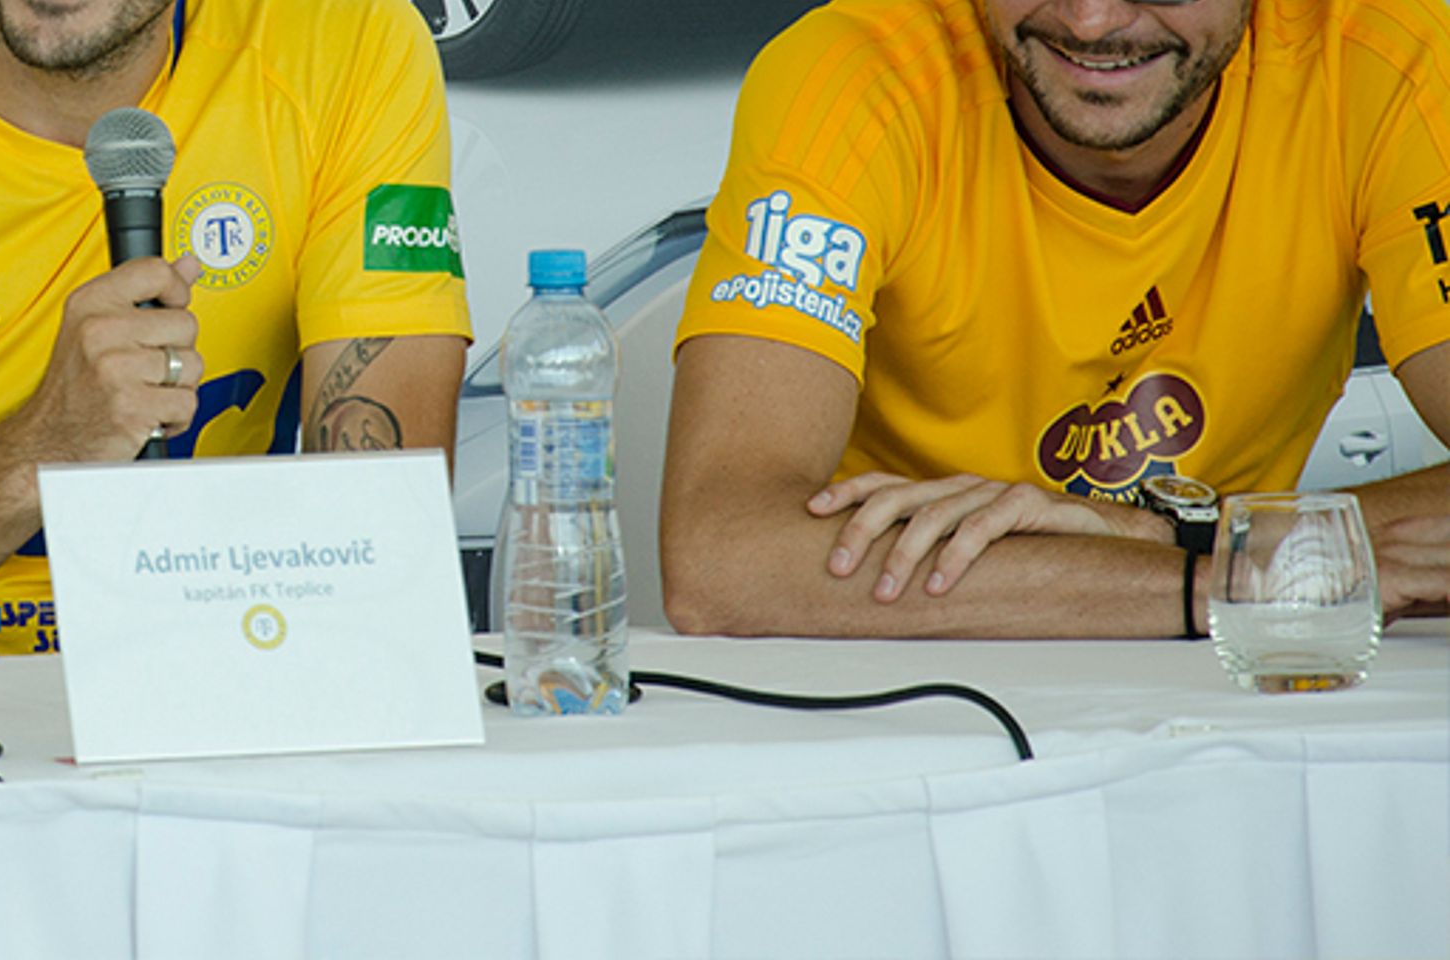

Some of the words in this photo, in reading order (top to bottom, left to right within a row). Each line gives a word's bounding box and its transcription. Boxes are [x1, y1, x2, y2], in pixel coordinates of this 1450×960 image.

[1412, 201, 1450, 265] T
[1111, 318, 1174, 356] adidas
[1054, 395, 1193, 461] DUKLA
[135, 548, 220, 574] Admir
[228, 539, 376, 576] Ljevakovič
[183, 584, 247, 603] kapitán
[250, 584, 271, 599] FK
[275, 581, 335, 601] Teplice
